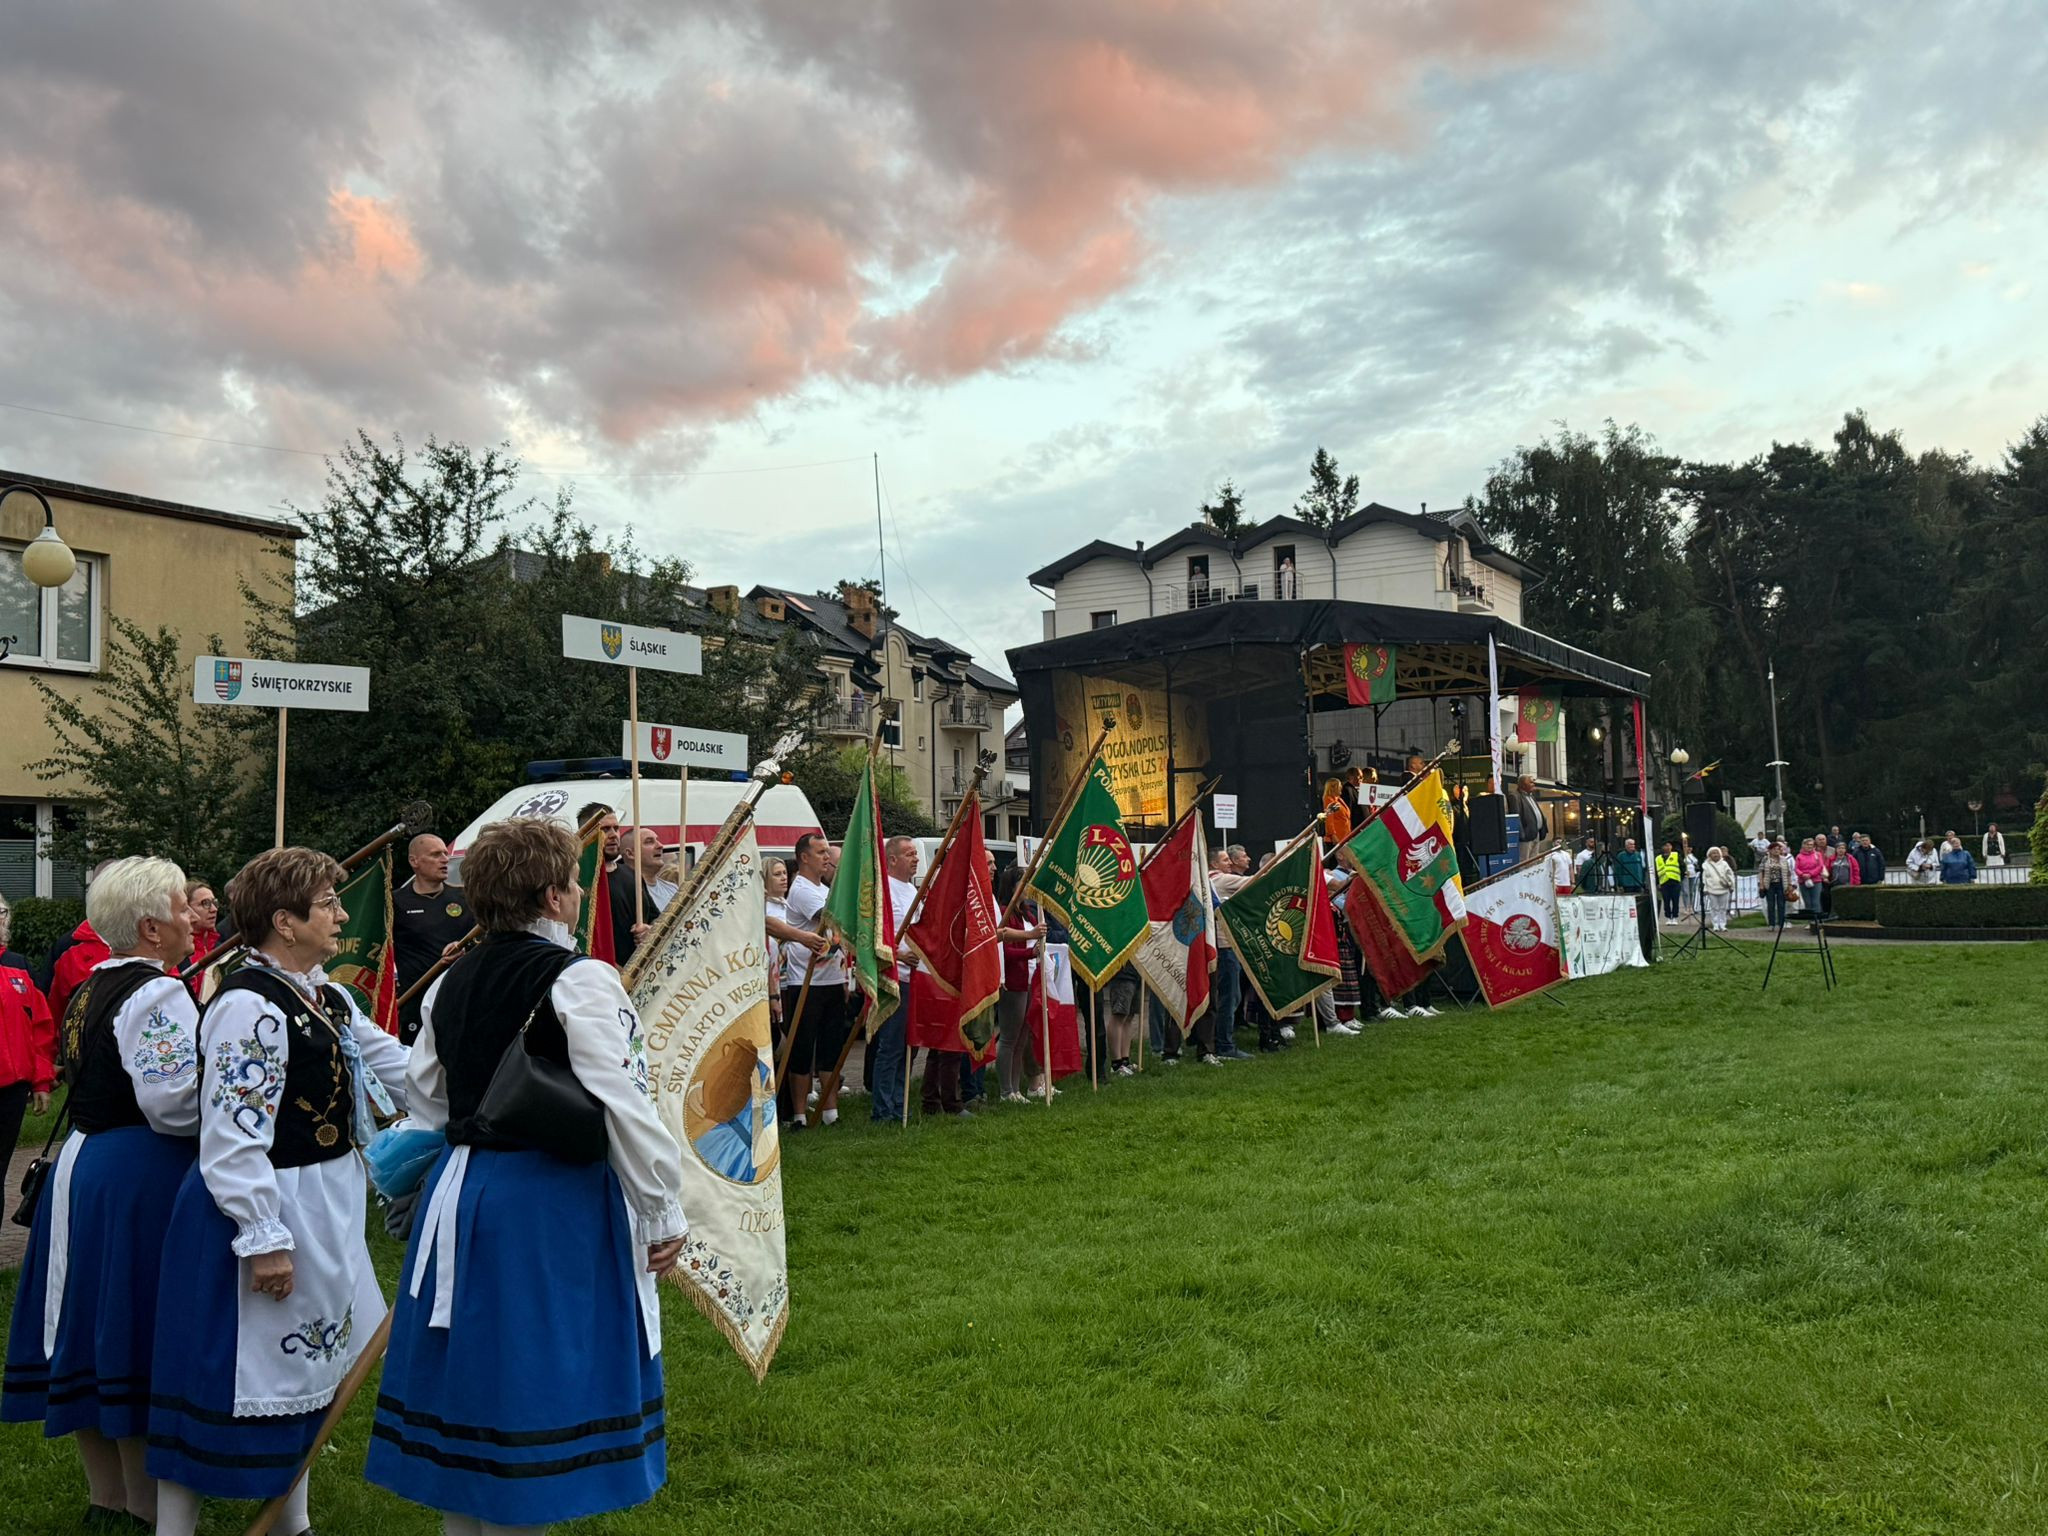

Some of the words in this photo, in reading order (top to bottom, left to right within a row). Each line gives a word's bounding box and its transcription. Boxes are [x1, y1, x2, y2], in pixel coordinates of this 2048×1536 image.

[629, 637, 667, 656] ŚLĄSKIE
[251, 672, 353, 693] ŚWIĘTOKRZYSKIE
[677, 739, 724, 755] PODLASKIE
[1105, 732, 1177, 760] OGÓLNOPOLSKE
[1141, 757, 1157, 775] LZS
[1091, 828, 1133, 873] LZS
[1048, 860, 1075, 886] LUDOW
[1075, 913, 1114, 954] SPORTOWE
[1518, 891, 1547, 907] SPORT
[1054, 880, 1067, 896] W
[1068, 922, 1093, 953] OWIE
[647, 965, 723, 1052] GMINNA
